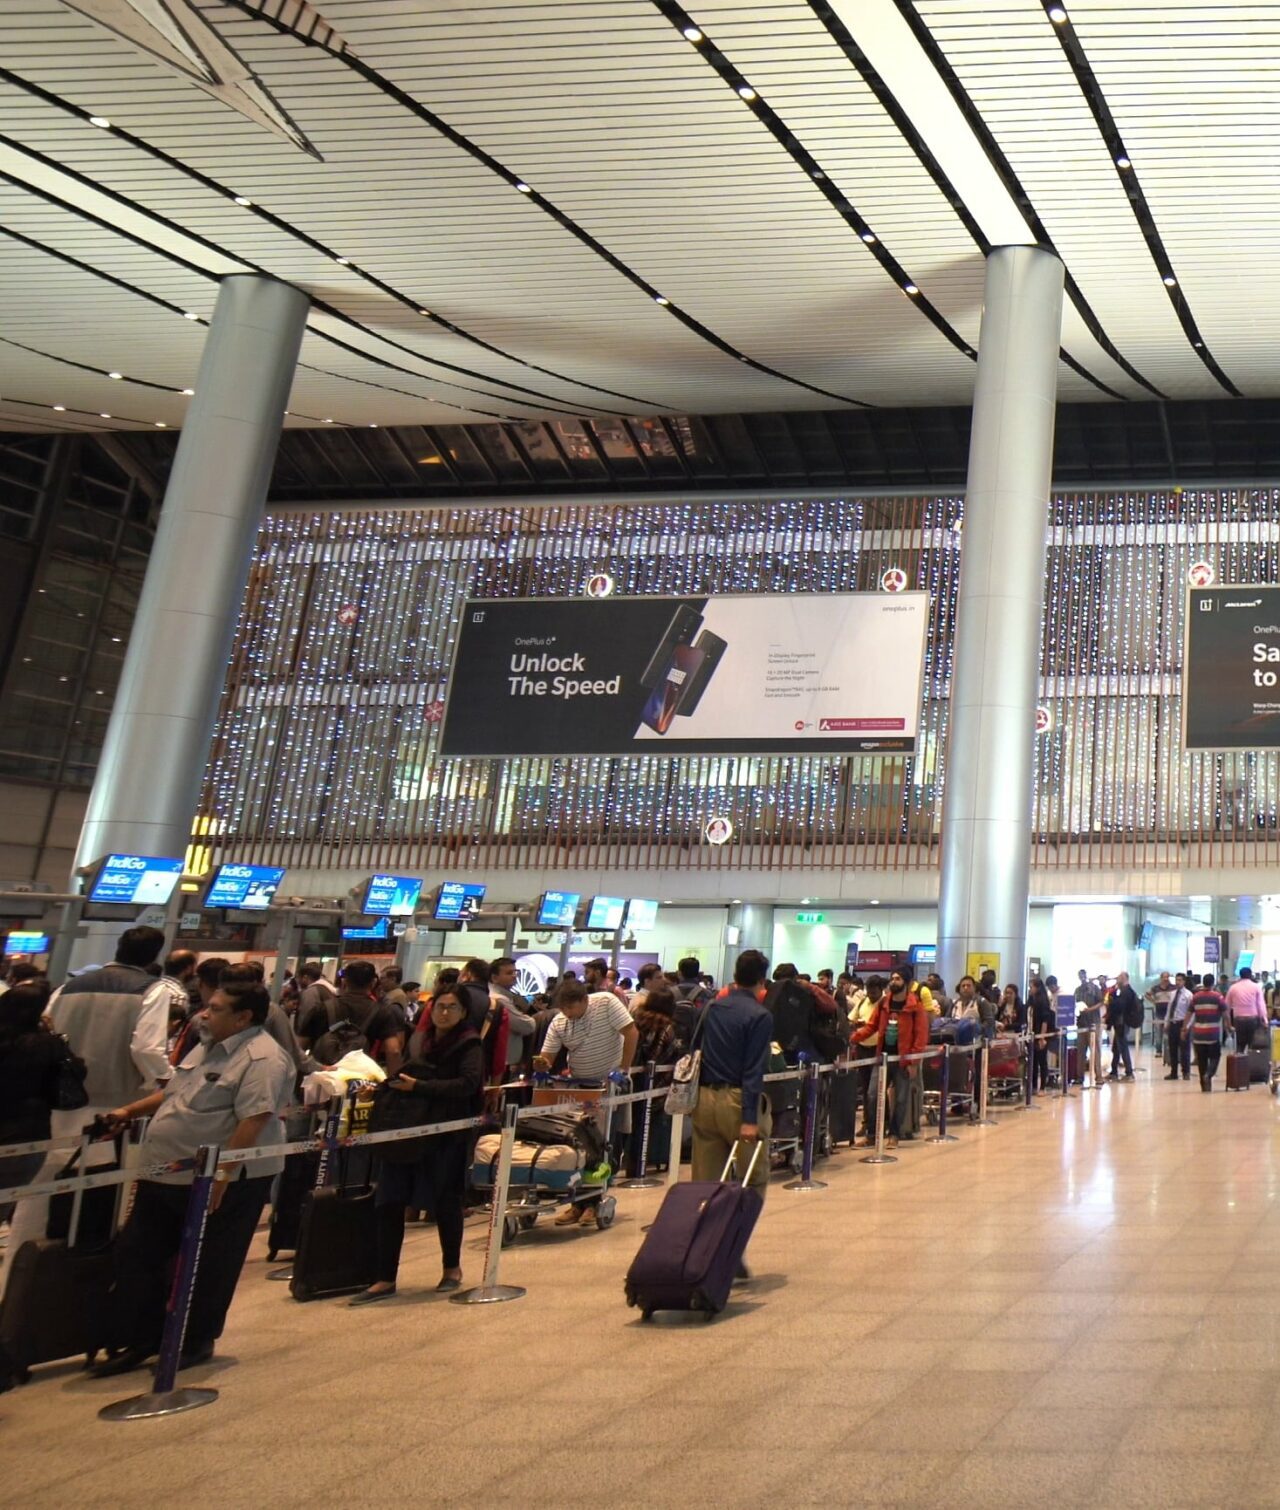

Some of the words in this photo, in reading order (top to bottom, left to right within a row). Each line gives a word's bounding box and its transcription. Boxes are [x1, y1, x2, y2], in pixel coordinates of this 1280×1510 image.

[514, 637, 545, 646] OnePlus
[510, 653, 585, 672] Unlock
[1253, 668, 1277, 687] to
[508, 676, 547, 696] The
[551, 675, 621, 699] Speed
[107, 855, 147, 870] IndiGo
[219, 863, 252, 878] IndiGo
[372, 876, 397, 888] IndiGo
[443, 883, 465, 894] IndiGo
[316, 1161, 327, 1185] DUTY
